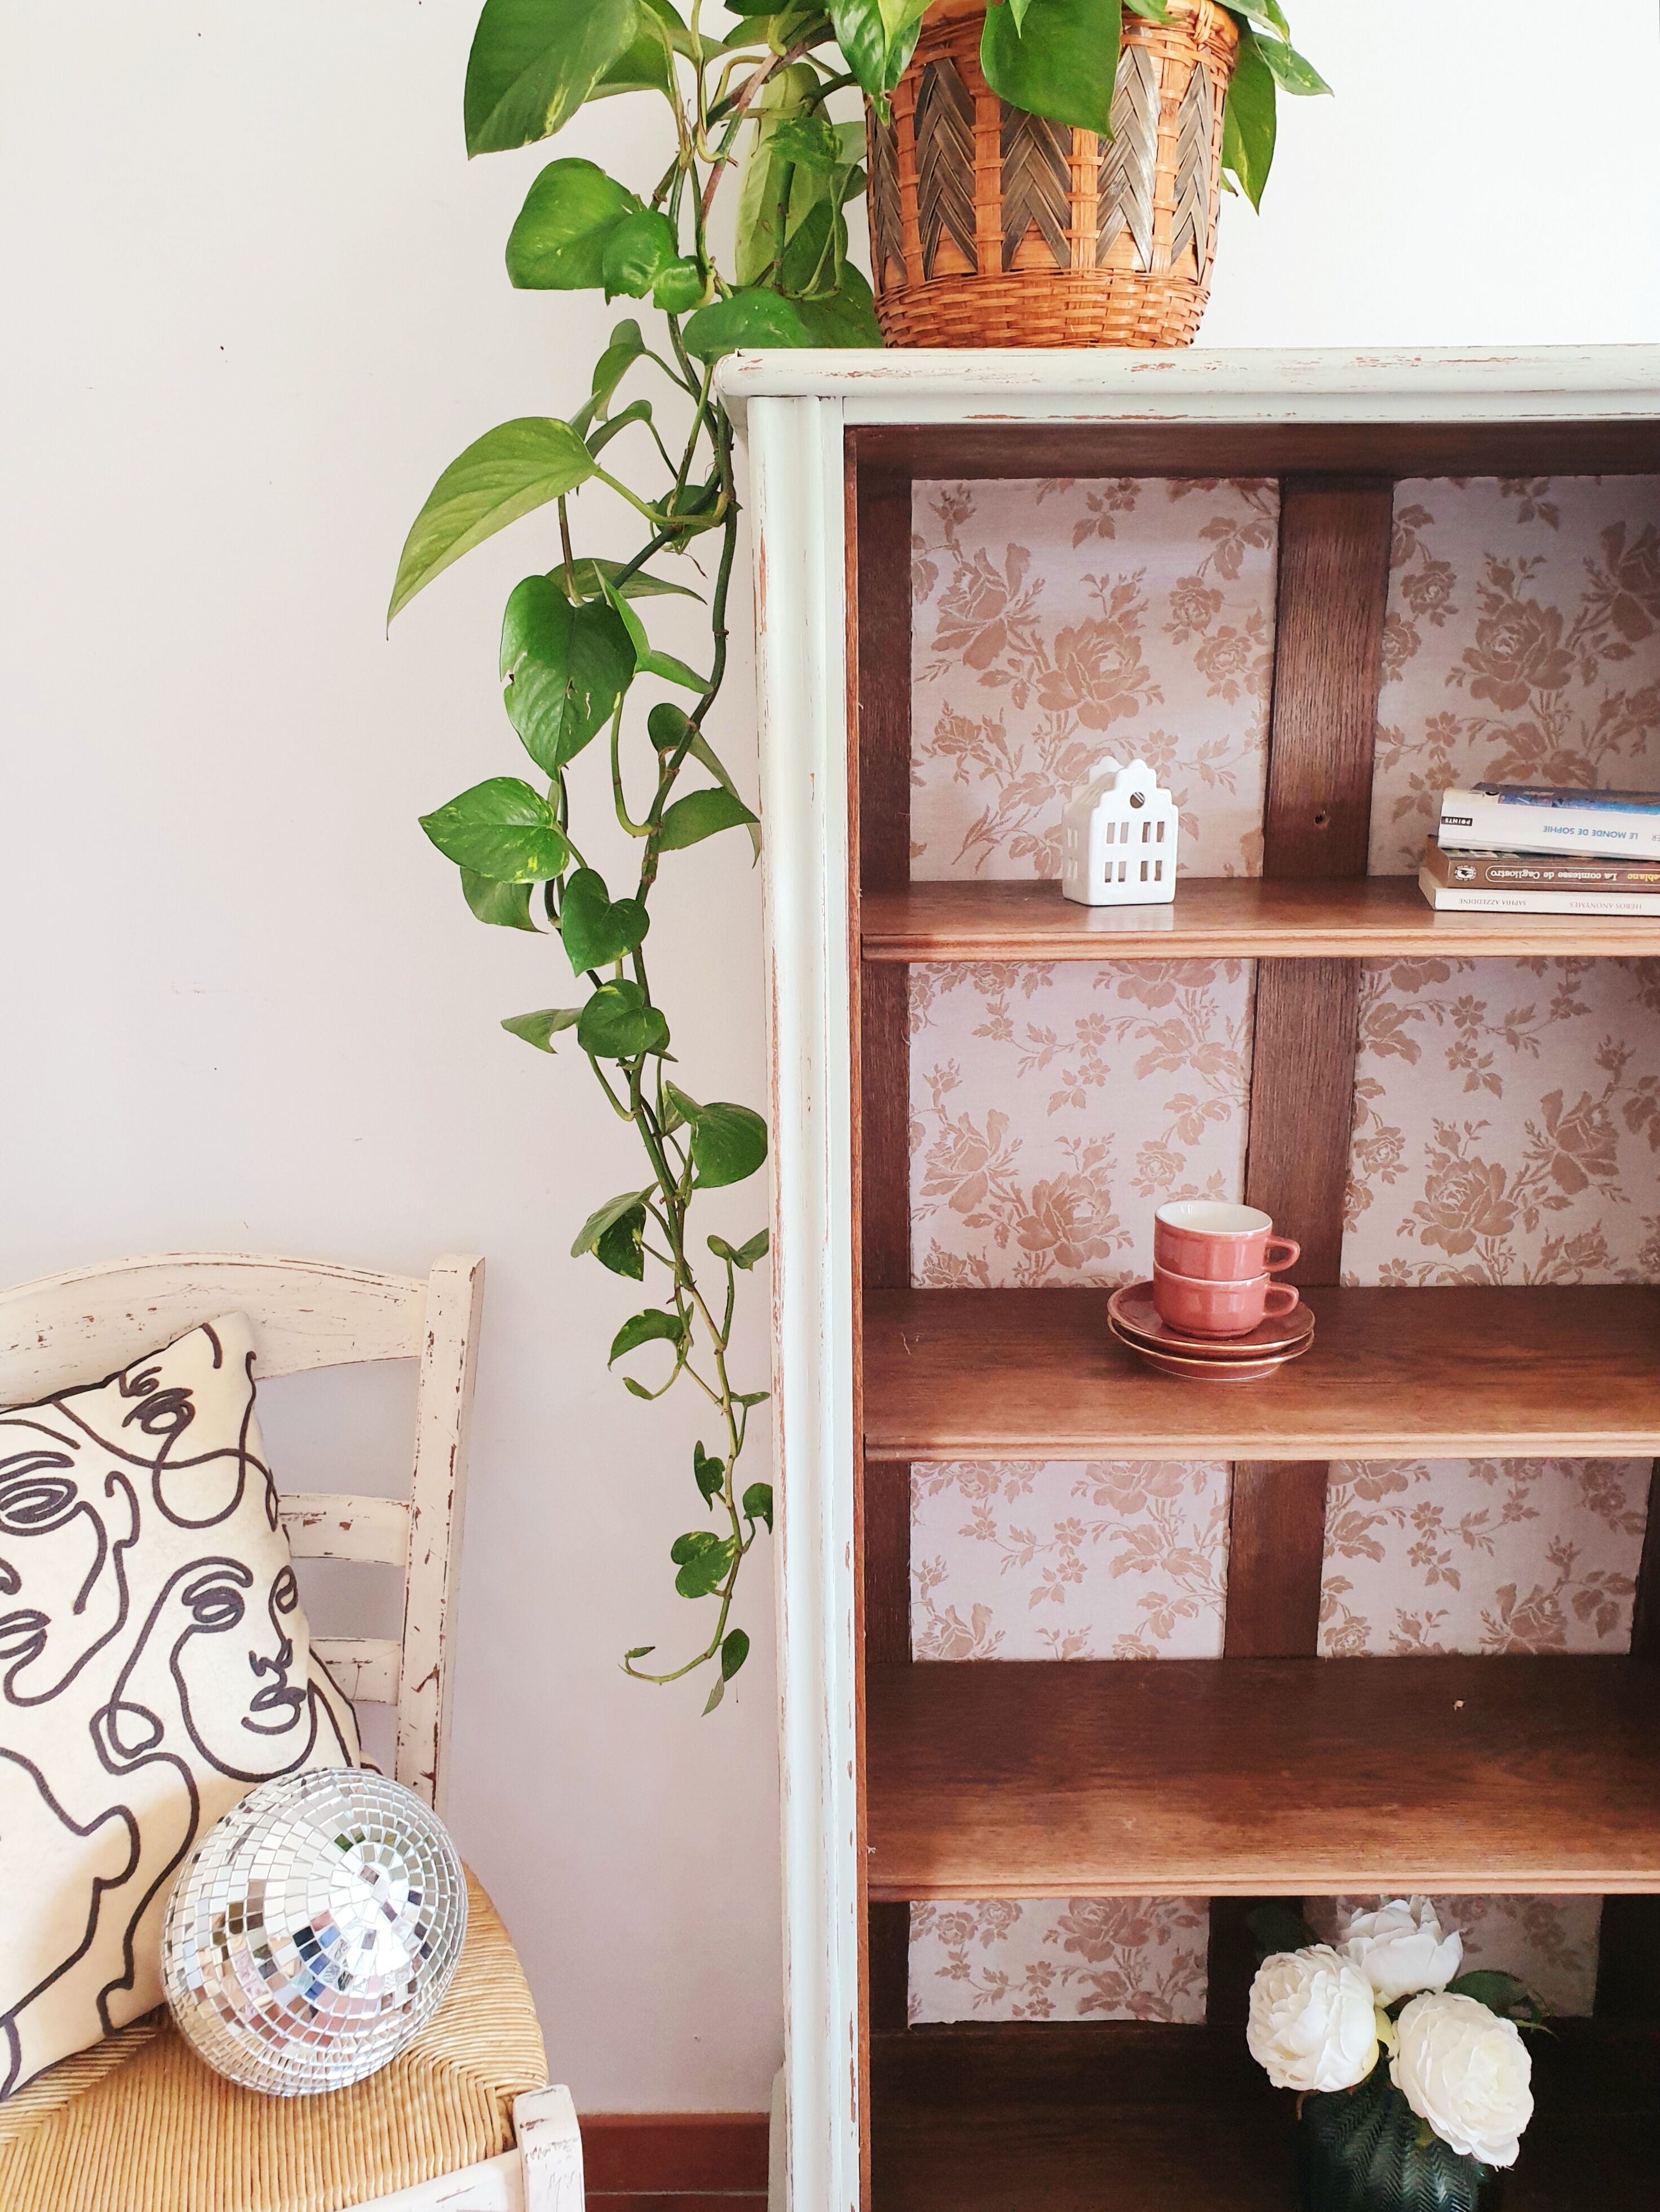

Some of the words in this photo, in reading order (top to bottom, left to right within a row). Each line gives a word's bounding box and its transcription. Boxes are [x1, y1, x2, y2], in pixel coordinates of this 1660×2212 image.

[1543, 826, 1575, 834] SOPHIE
[1591, 830, 1627, 839] MONDE
[1490, 870, 1540, 879] Cagliostro
[1604, 873, 1617, 881] La
[1627, 873, 1660, 882] eblanc
[1570, 901, 1614, 910] ANONYMES
